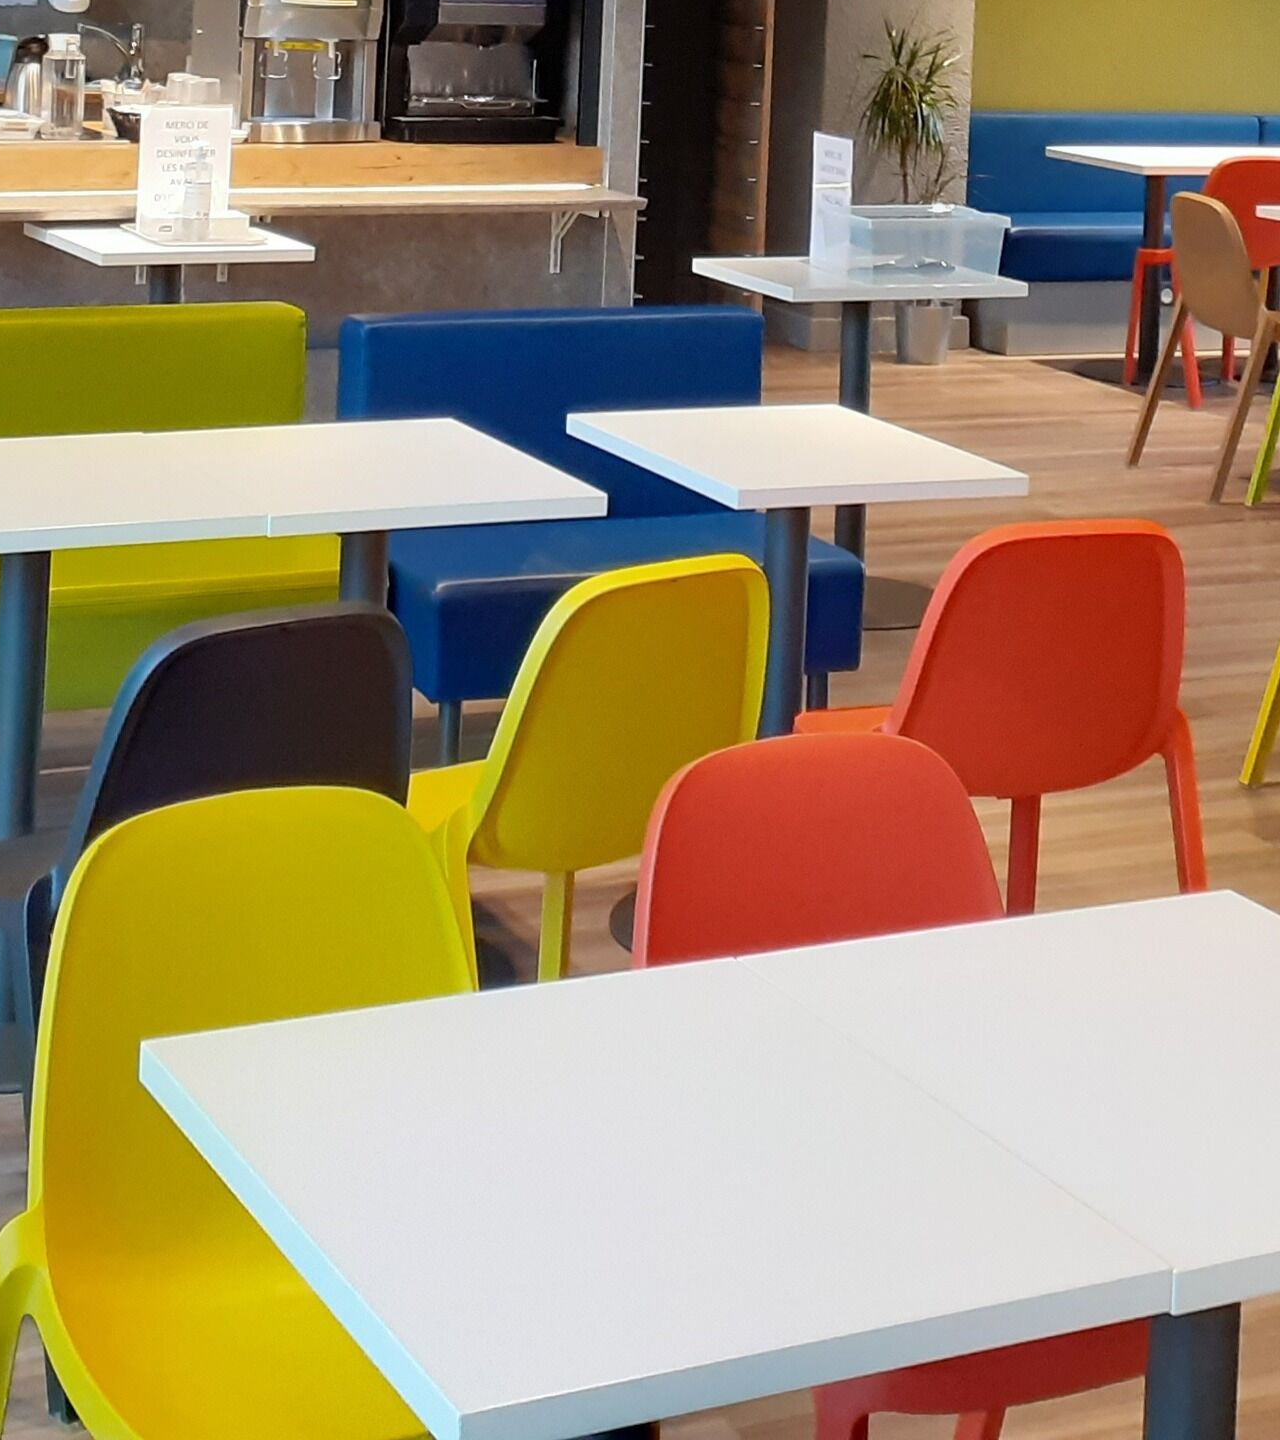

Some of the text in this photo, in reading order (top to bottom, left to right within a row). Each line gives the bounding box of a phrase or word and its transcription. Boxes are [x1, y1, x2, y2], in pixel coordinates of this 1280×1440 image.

[165, 120, 209, 129] MERCI DE
[161, 163, 177, 173] LES
